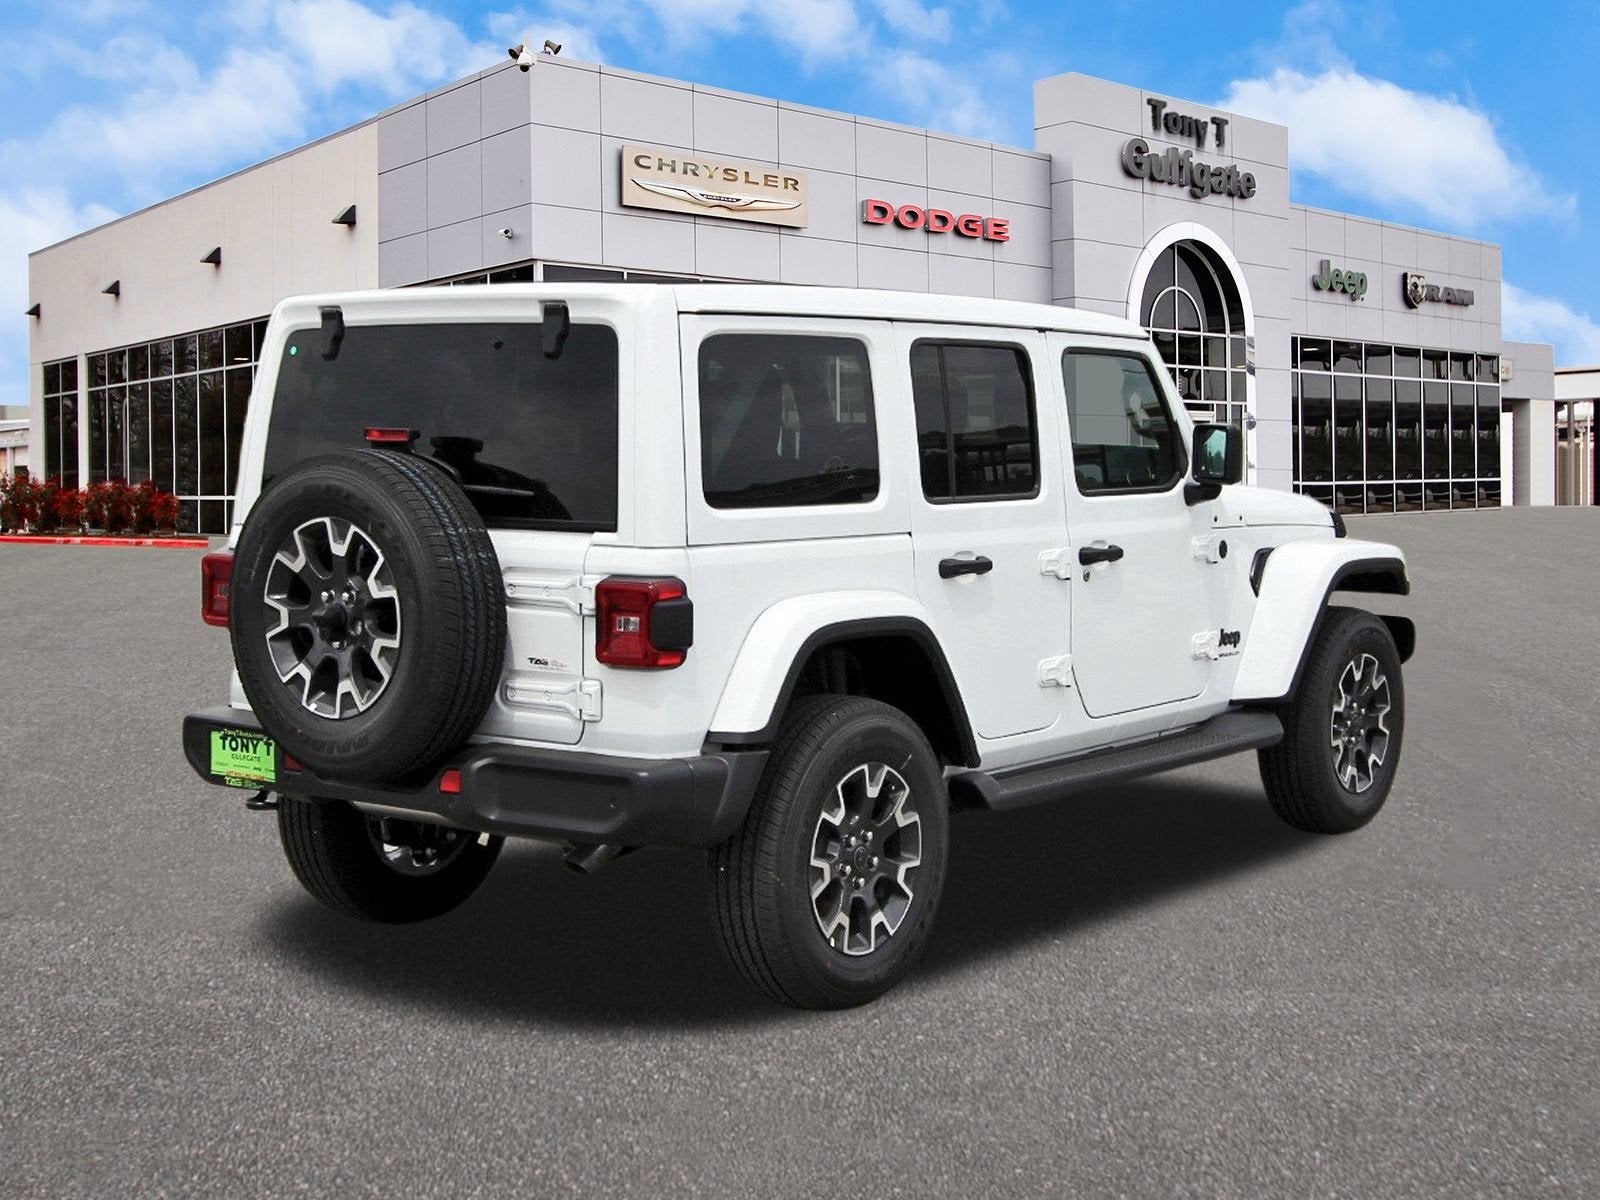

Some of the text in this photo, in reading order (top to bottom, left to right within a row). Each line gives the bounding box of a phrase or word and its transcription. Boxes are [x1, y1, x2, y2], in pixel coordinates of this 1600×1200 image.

[1146, 97, 1229, 148] Tony T
[633, 154, 800, 192] CHRYSLER
[1121, 138, 1257, 199] Gulfgate
[862, 198, 1010, 242] DODGE
[1312, 259, 1368, 302] Jeep
[1425, 283, 1475, 306] RAM
[1218, 628, 1241, 648] Jeep
[219, 734, 273, 756] TONY T
